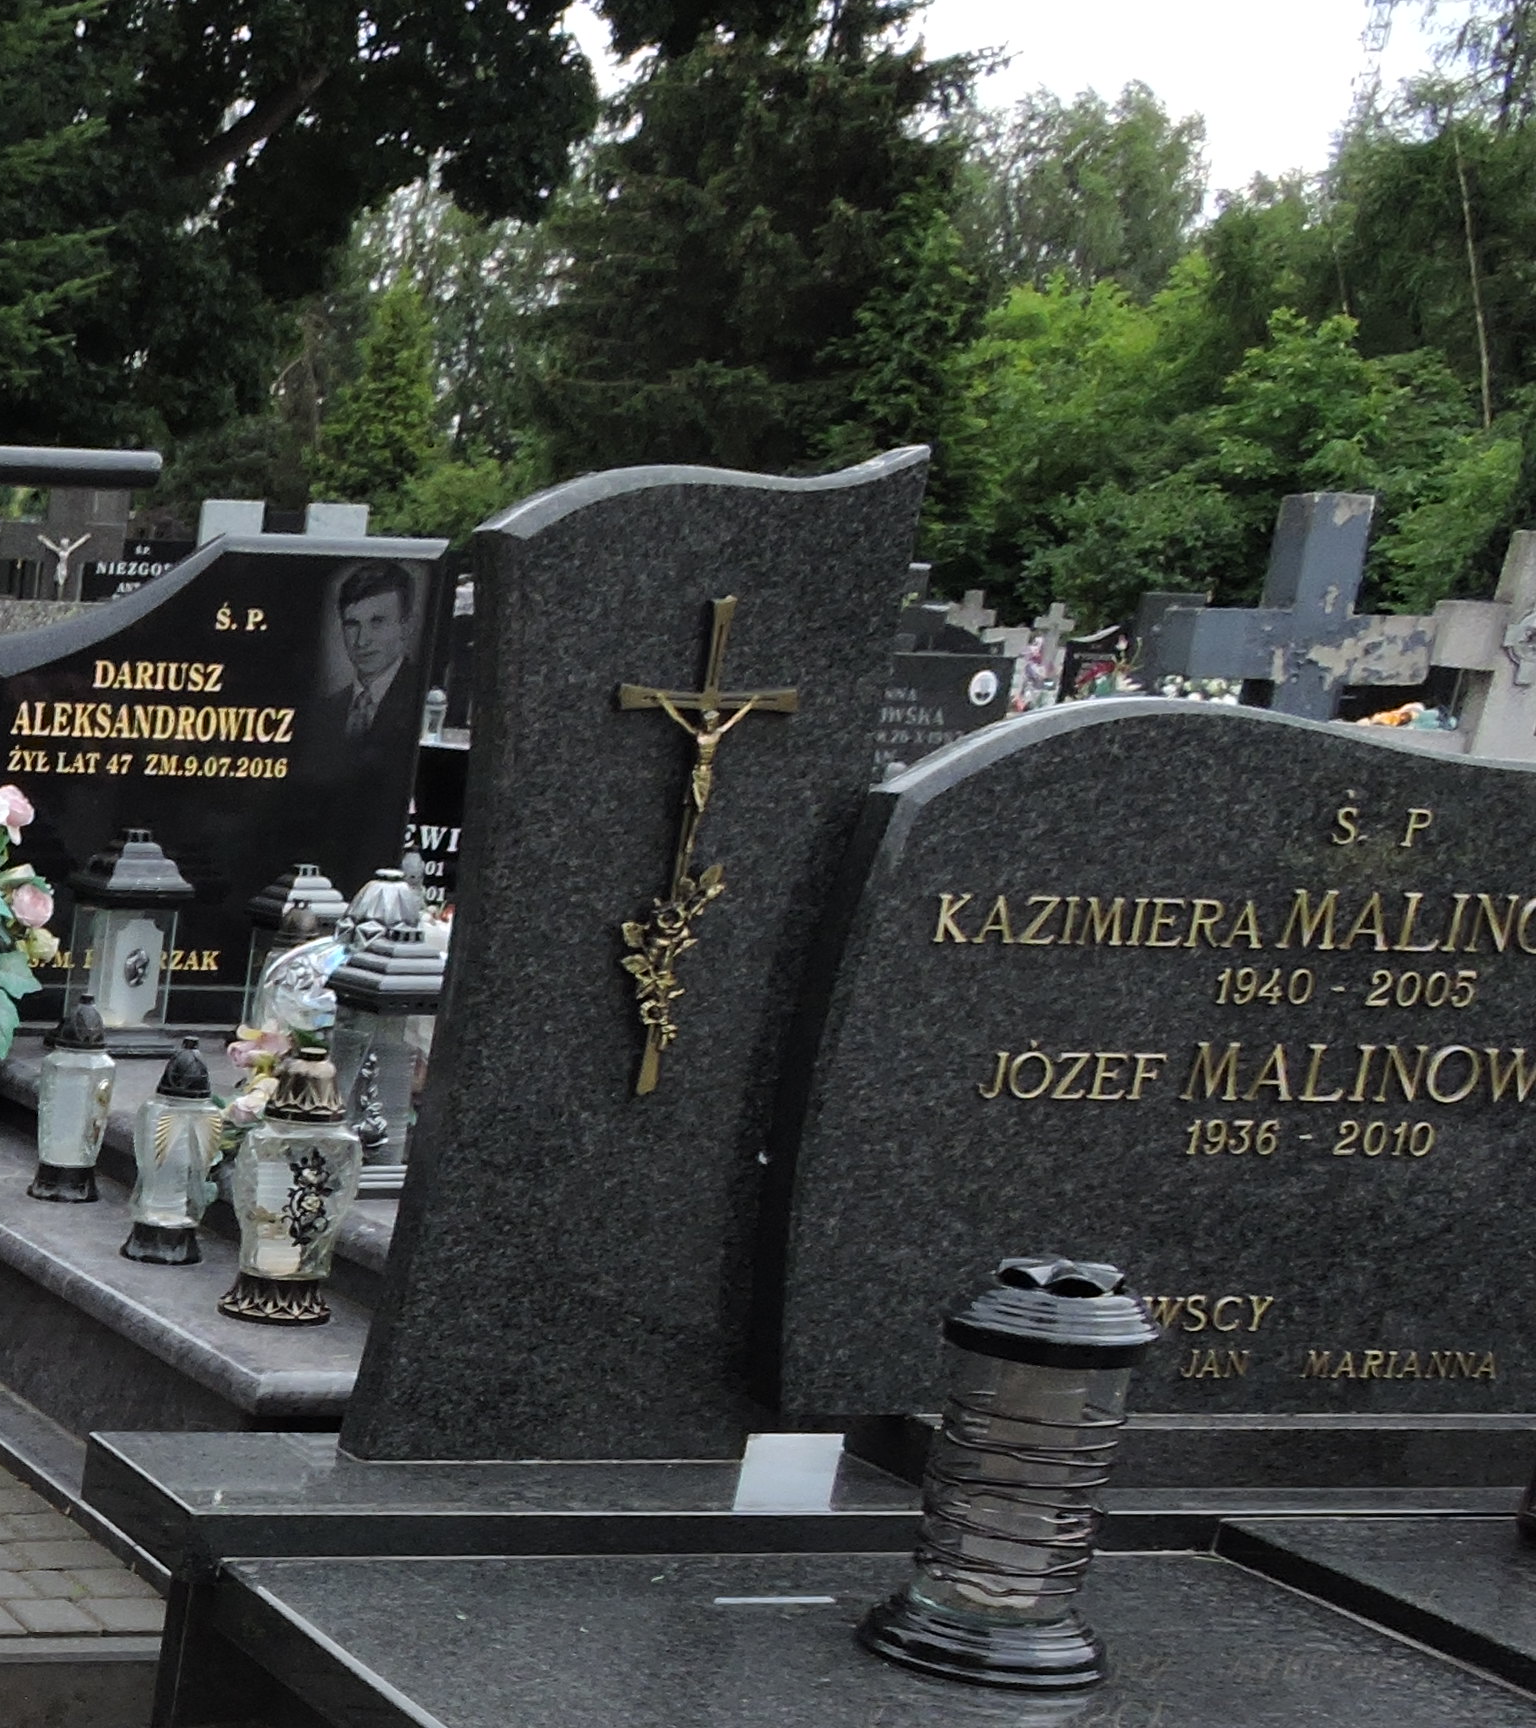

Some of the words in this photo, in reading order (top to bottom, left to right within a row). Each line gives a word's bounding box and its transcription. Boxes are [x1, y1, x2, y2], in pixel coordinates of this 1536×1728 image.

[214, 601, 238, 631] Ś.
[244, 607, 268, 631] P.
[91, 659, 225, 692] DARIUSZ
[10, 699, 296, 743] ALEKSANDROWICZ
[6, 744, 50, 773] ŻYŁ
[55, 750, 102, 775] LAT
[105, 752, 134, 775] 47
[143, 753, 289, 778] ZM.9.07.2016
[932, 892, 1263, 949] KAZIMIERA
[1214, 966, 1316, 1005] 1940
[1364, 968, 1478, 1008] 2005
[978, 1039, 1169, 1101] JÓZEF
[1185, 1118, 1282, 1155] 1936
[1331, 1119, 1436, 1157] 2010
[1142, 1294, 1274, 1333] WSCY
[1180, 1349, 1251, 1379] JAN
[1299, 1349, 1498, 1380] MARIANNA
